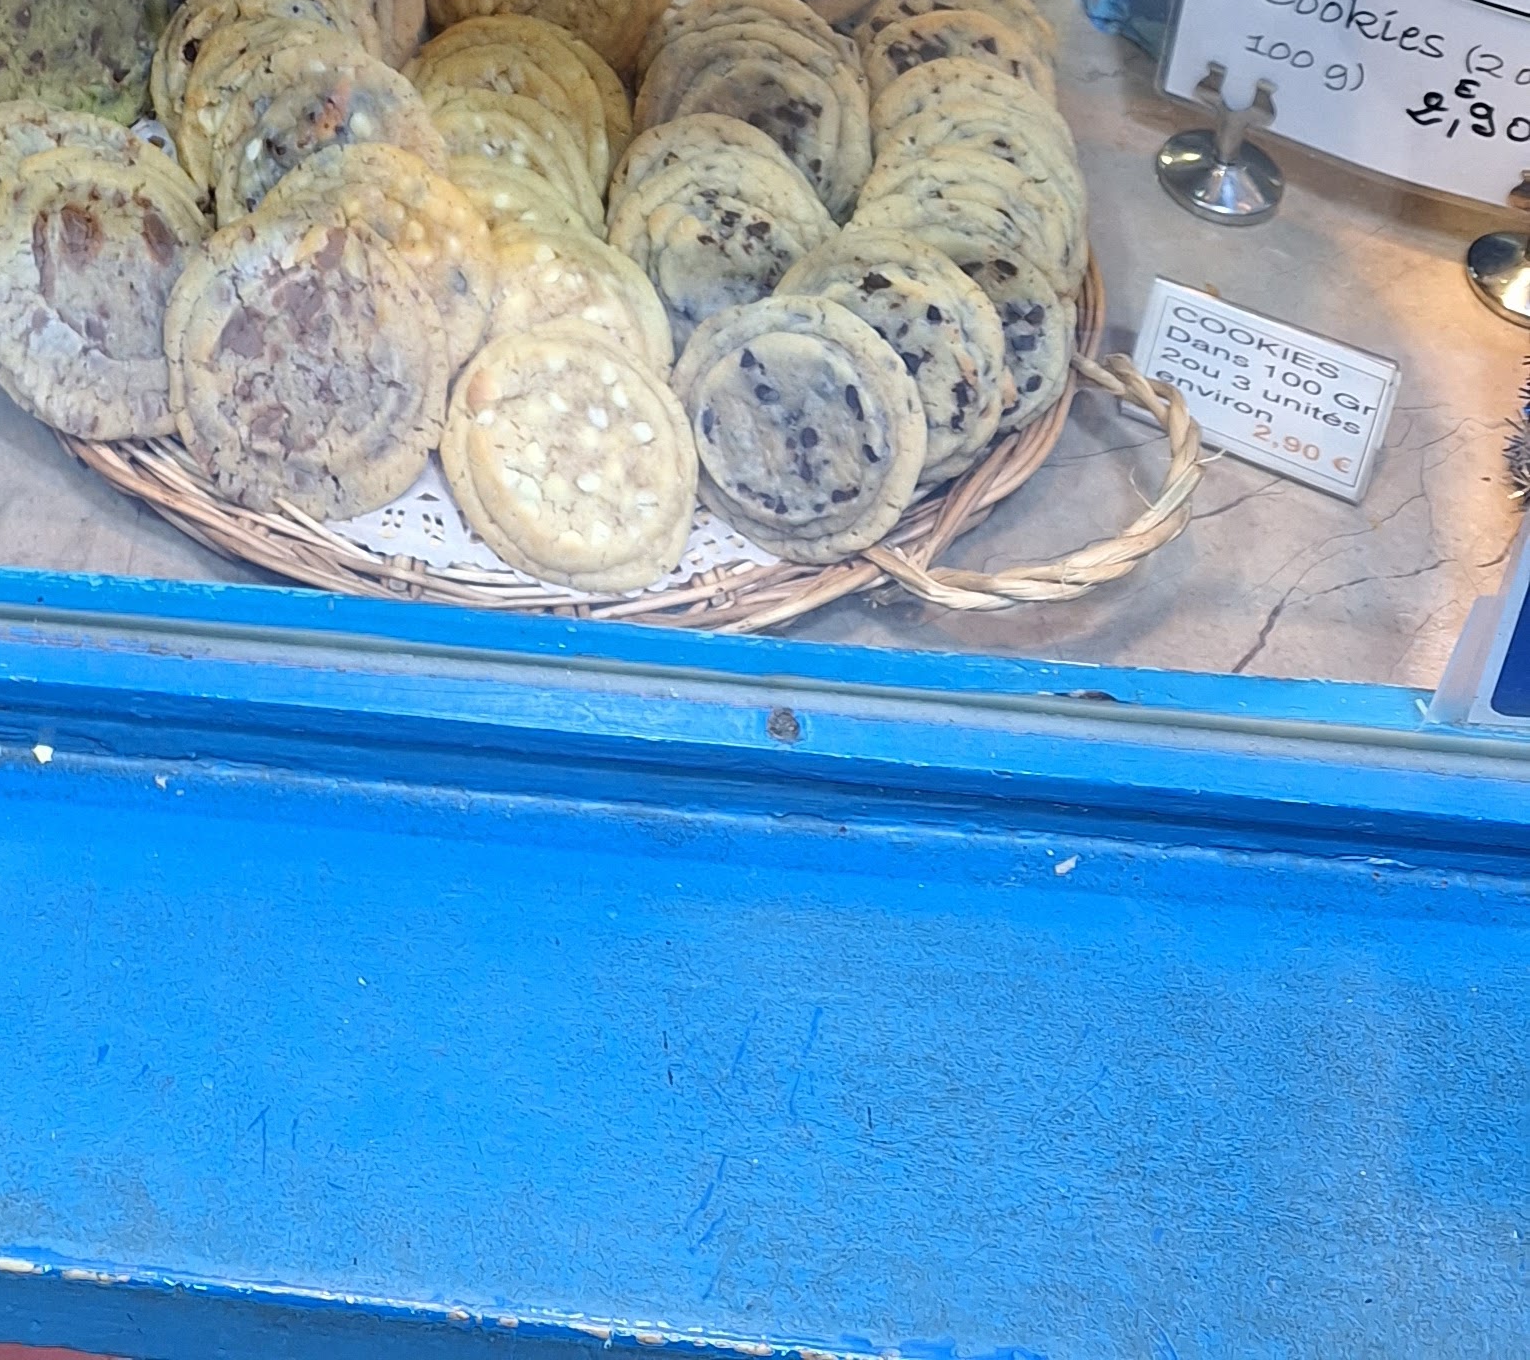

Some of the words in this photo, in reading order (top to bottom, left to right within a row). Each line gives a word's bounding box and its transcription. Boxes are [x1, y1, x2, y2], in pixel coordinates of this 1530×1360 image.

[1245, 34, 1314, 69] 100
[1166, 325, 1250, 368] Dans
[1263, 365, 1322, 396] 100
[1333, 392, 1378, 416] Gr
[1172, 306, 1340, 380] COOKIES
[1155, 370, 1274, 423] environ
[1231, 374, 1251, 391] 3
[1263, 389, 1361, 435] unités
[1332, 457, 1353, 474] €
